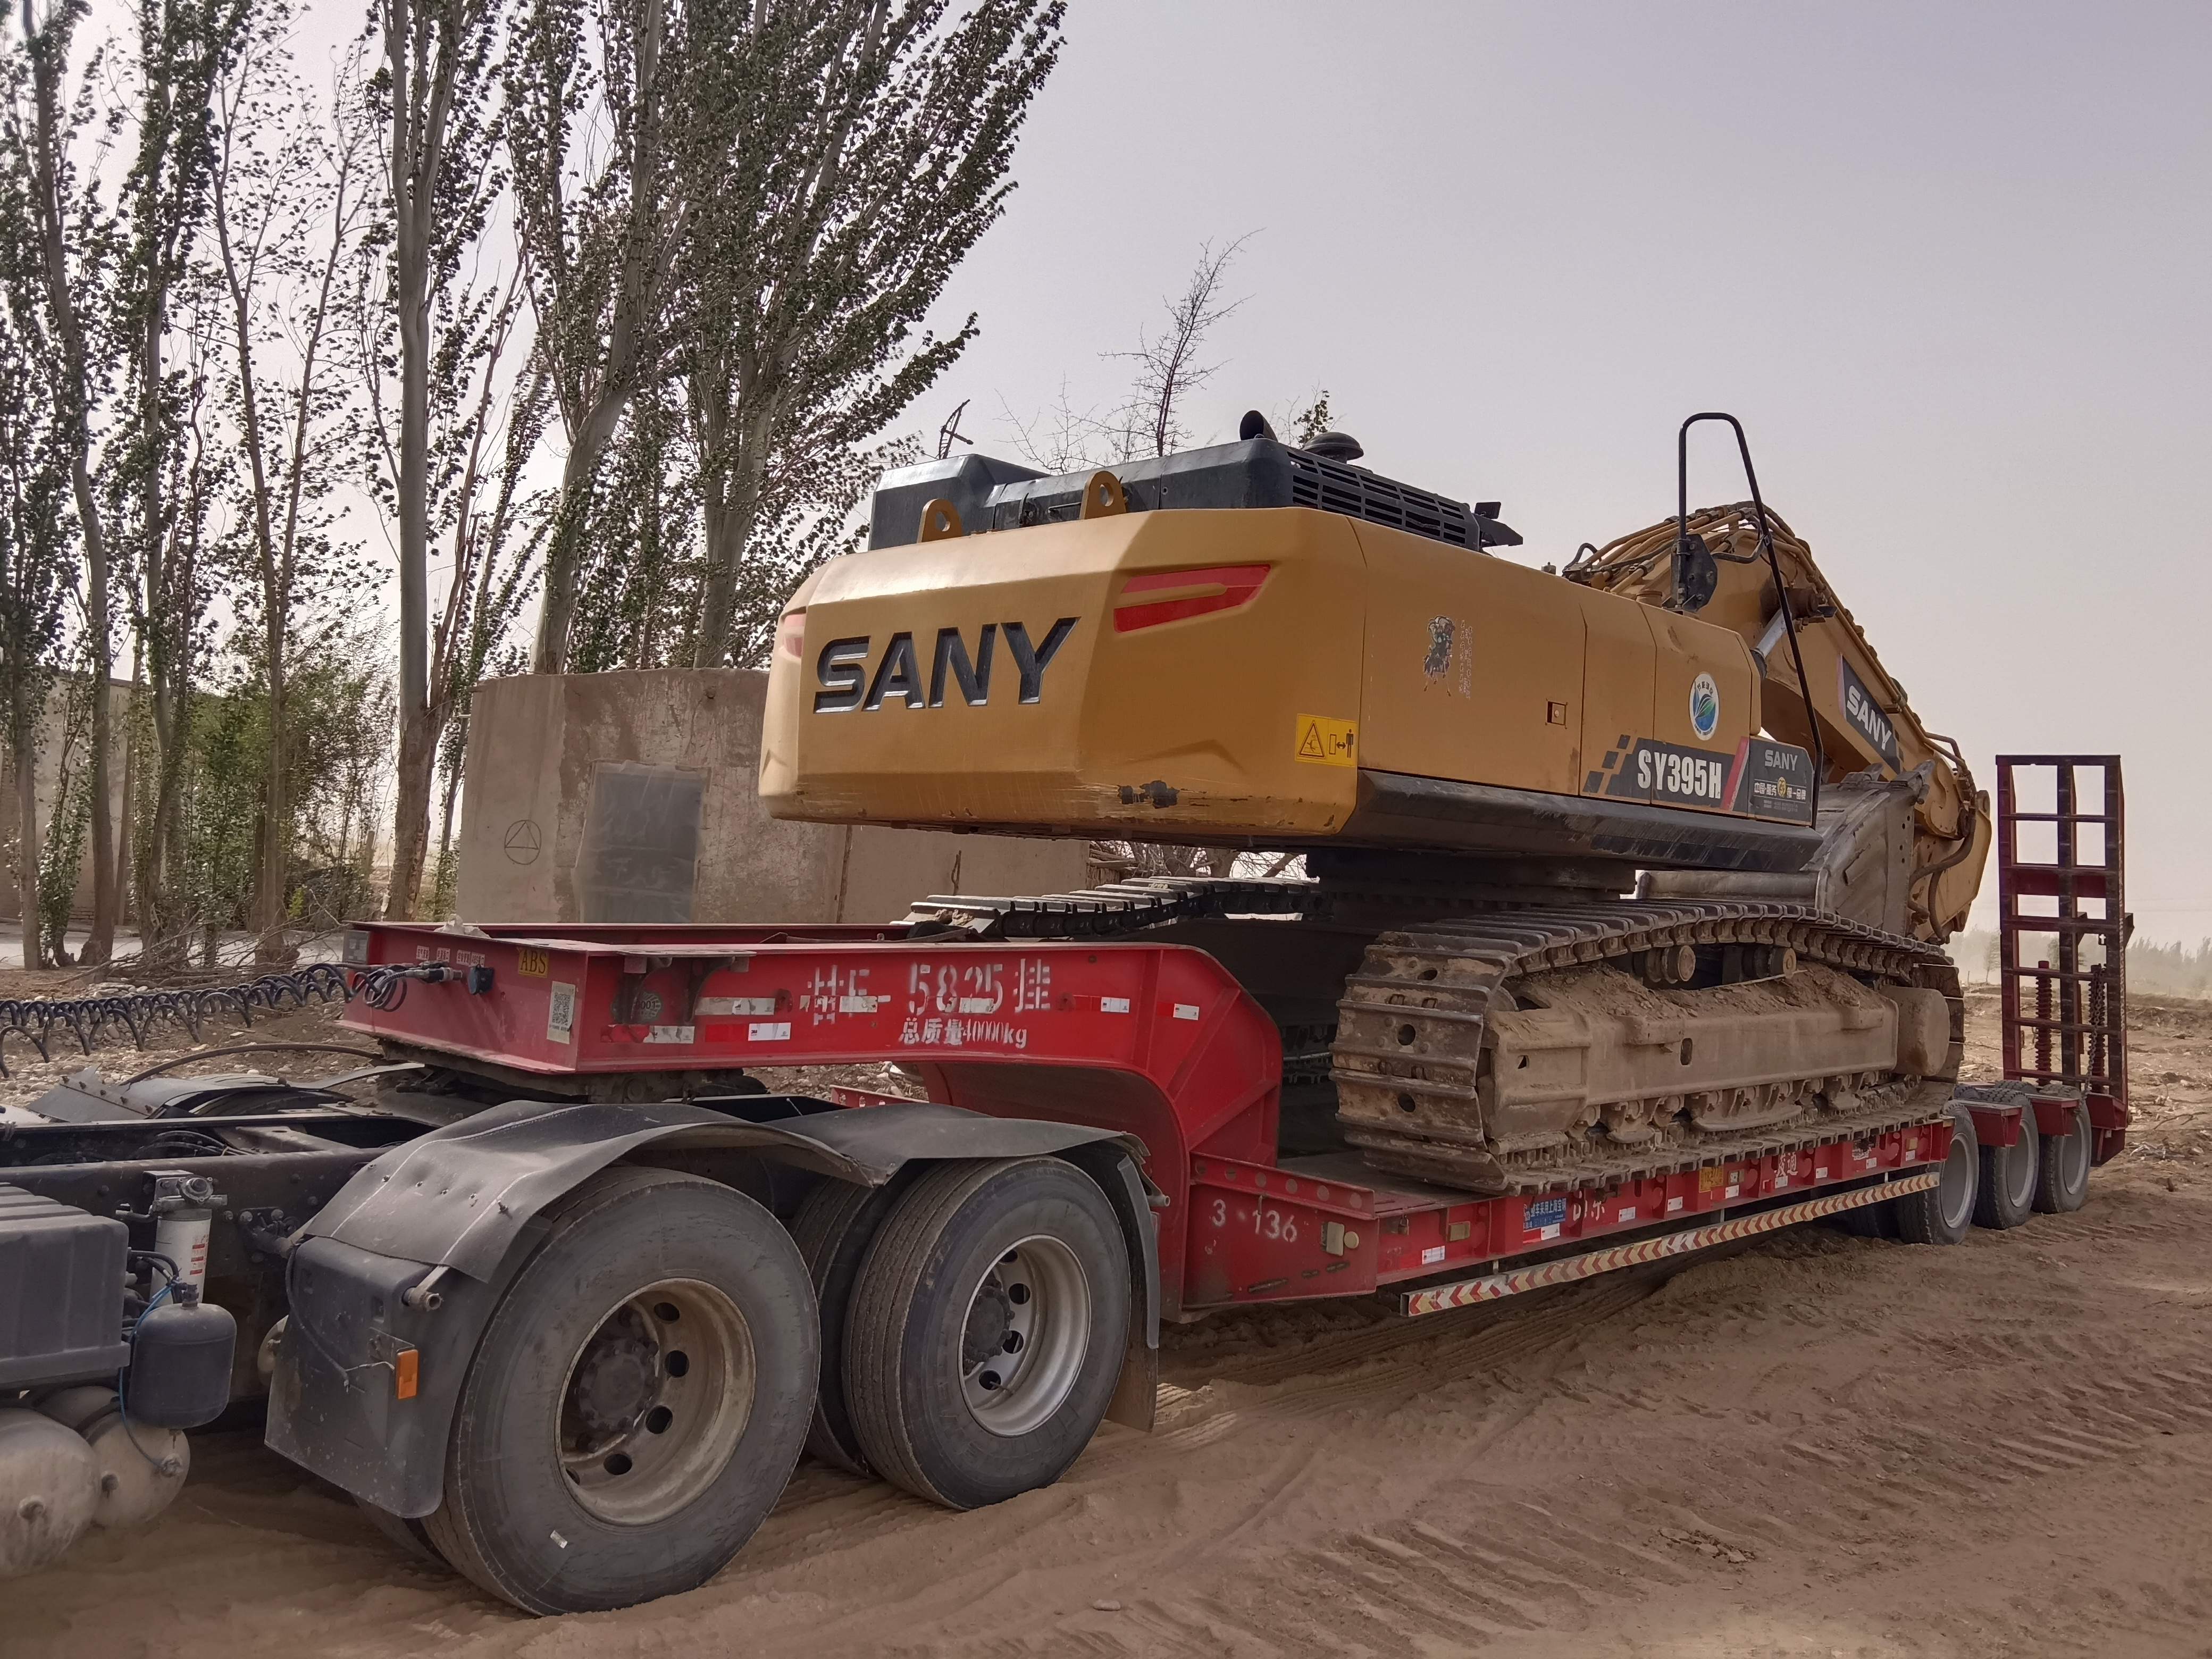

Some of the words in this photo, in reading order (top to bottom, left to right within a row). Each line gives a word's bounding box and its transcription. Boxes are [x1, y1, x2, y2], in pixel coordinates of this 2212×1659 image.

[813, 616, 1082, 714] SANY
[1846, 685, 1892, 751] SANY
[1637, 749, 1722, 799] SY395H
[1765, 749, 1798, 771] SANY
[520, 950, 547, 974] ABS
